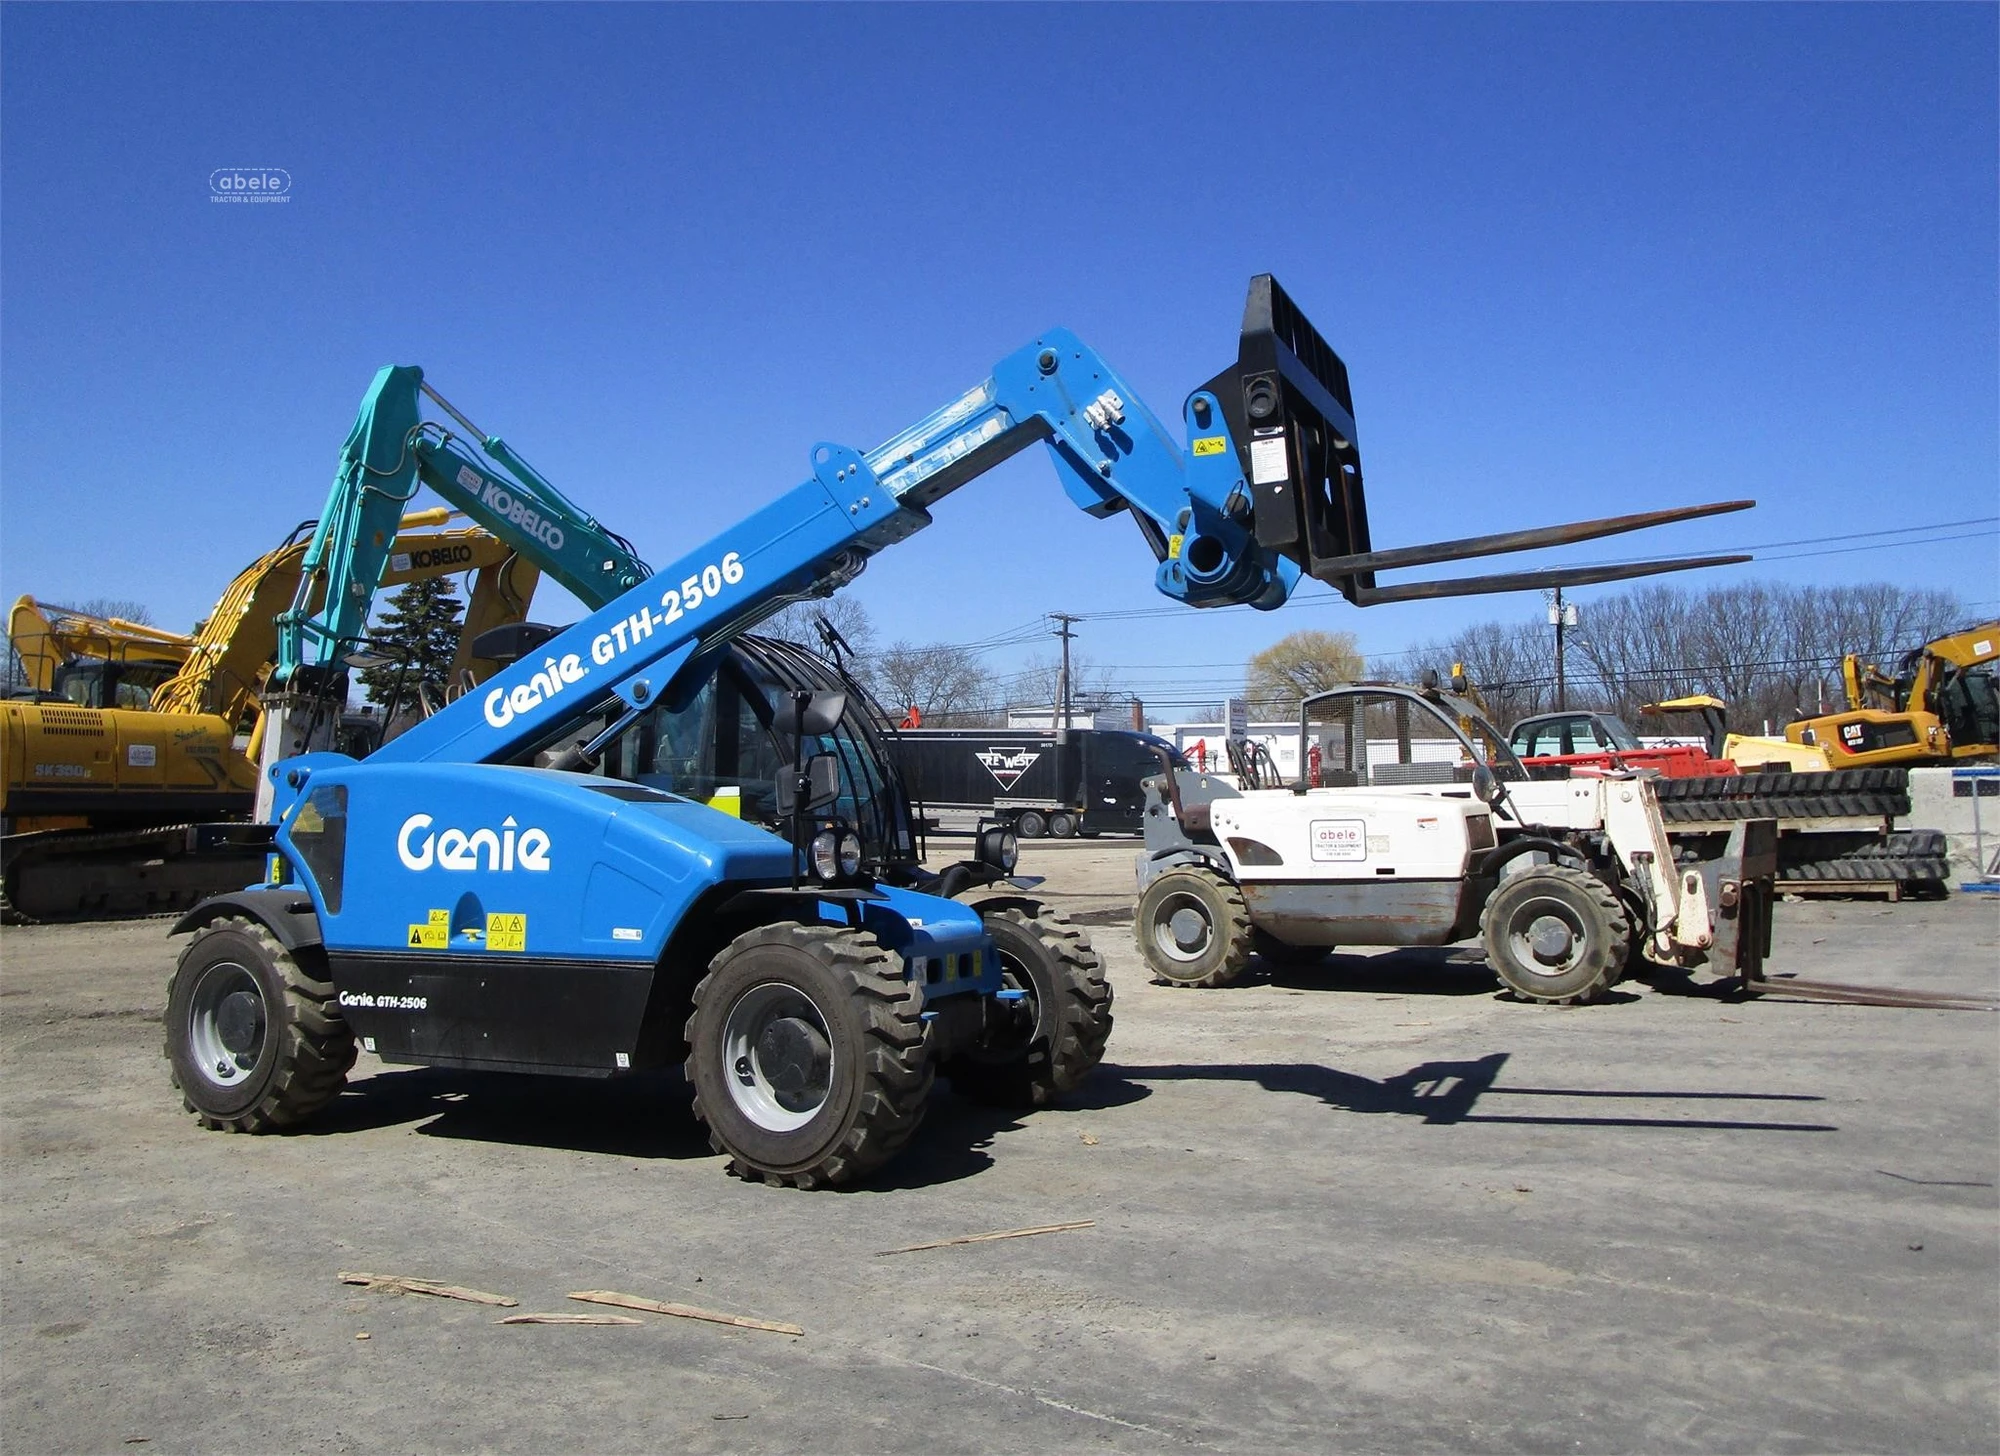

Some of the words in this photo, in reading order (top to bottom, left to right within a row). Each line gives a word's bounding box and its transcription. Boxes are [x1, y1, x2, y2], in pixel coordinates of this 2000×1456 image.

[481, 481, 564, 550] KOBELCO
[410, 544, 472, 569] KOBELCO
[484, 656, 586, 728] Genie
[591, 551, 744, 665] GTH-2506
[1843, 724, 1862, 739] CAT
[1003, 756, 1030, 769] WEST
[397, 813, 551, 872] Genie
[1320, 829, 1356, 840] abele
[339, 990, 375, 1007] Genie
[376, 995, 428, 1010] GTH-2506
